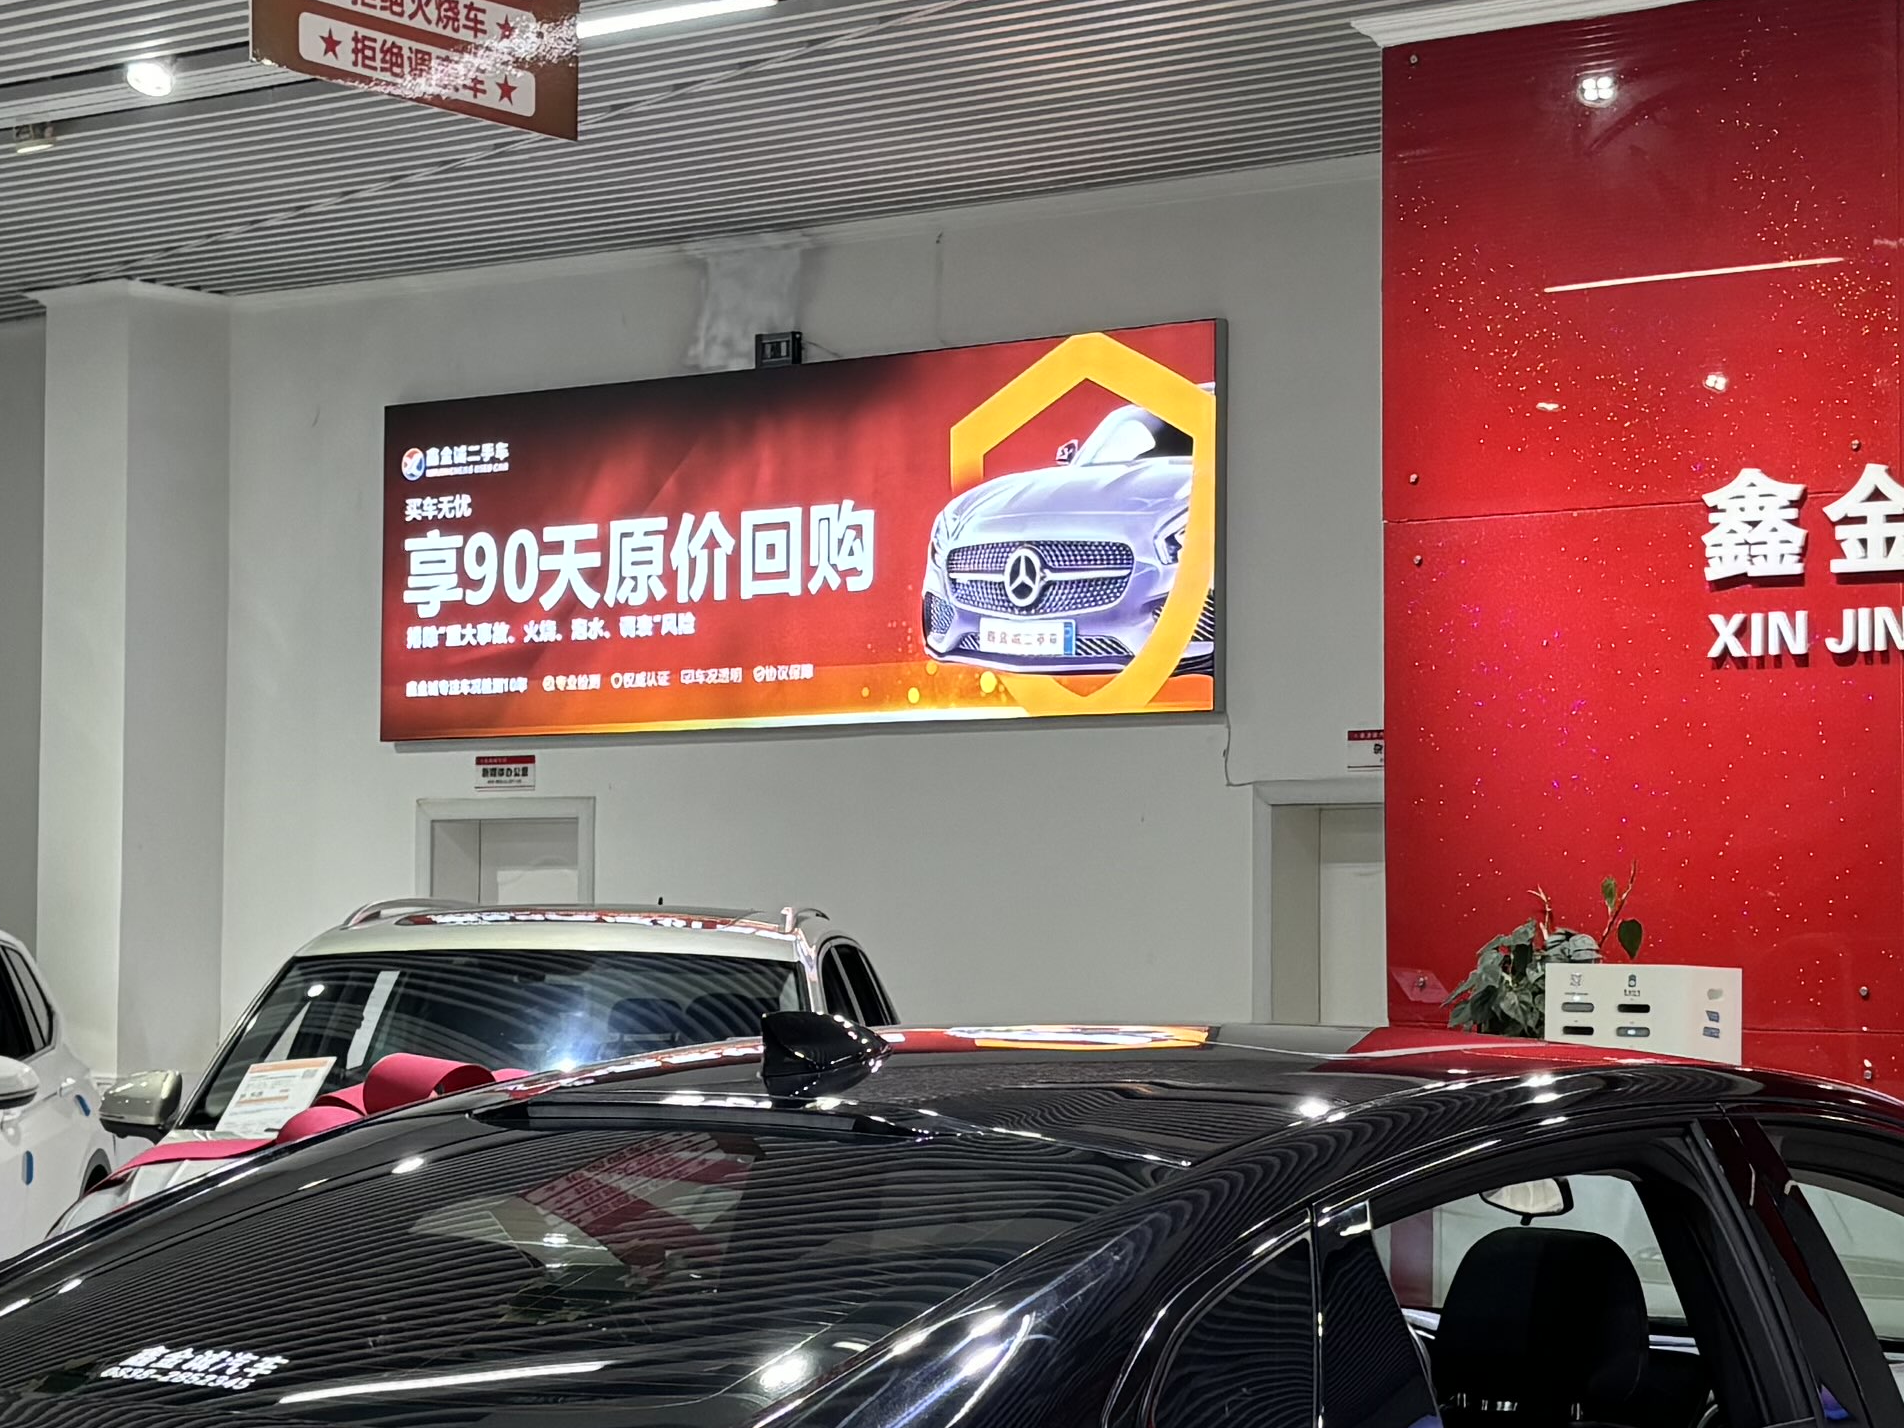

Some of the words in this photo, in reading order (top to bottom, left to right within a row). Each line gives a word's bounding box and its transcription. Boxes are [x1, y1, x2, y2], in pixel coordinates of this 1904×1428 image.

[351, 31, 487, 100] 拒绝调车
[405, 494, 473, 522] 买车无忧
[403, 500, 875, 619] 享90天原价回购
[1707, 610, 1808, 659] XIN
